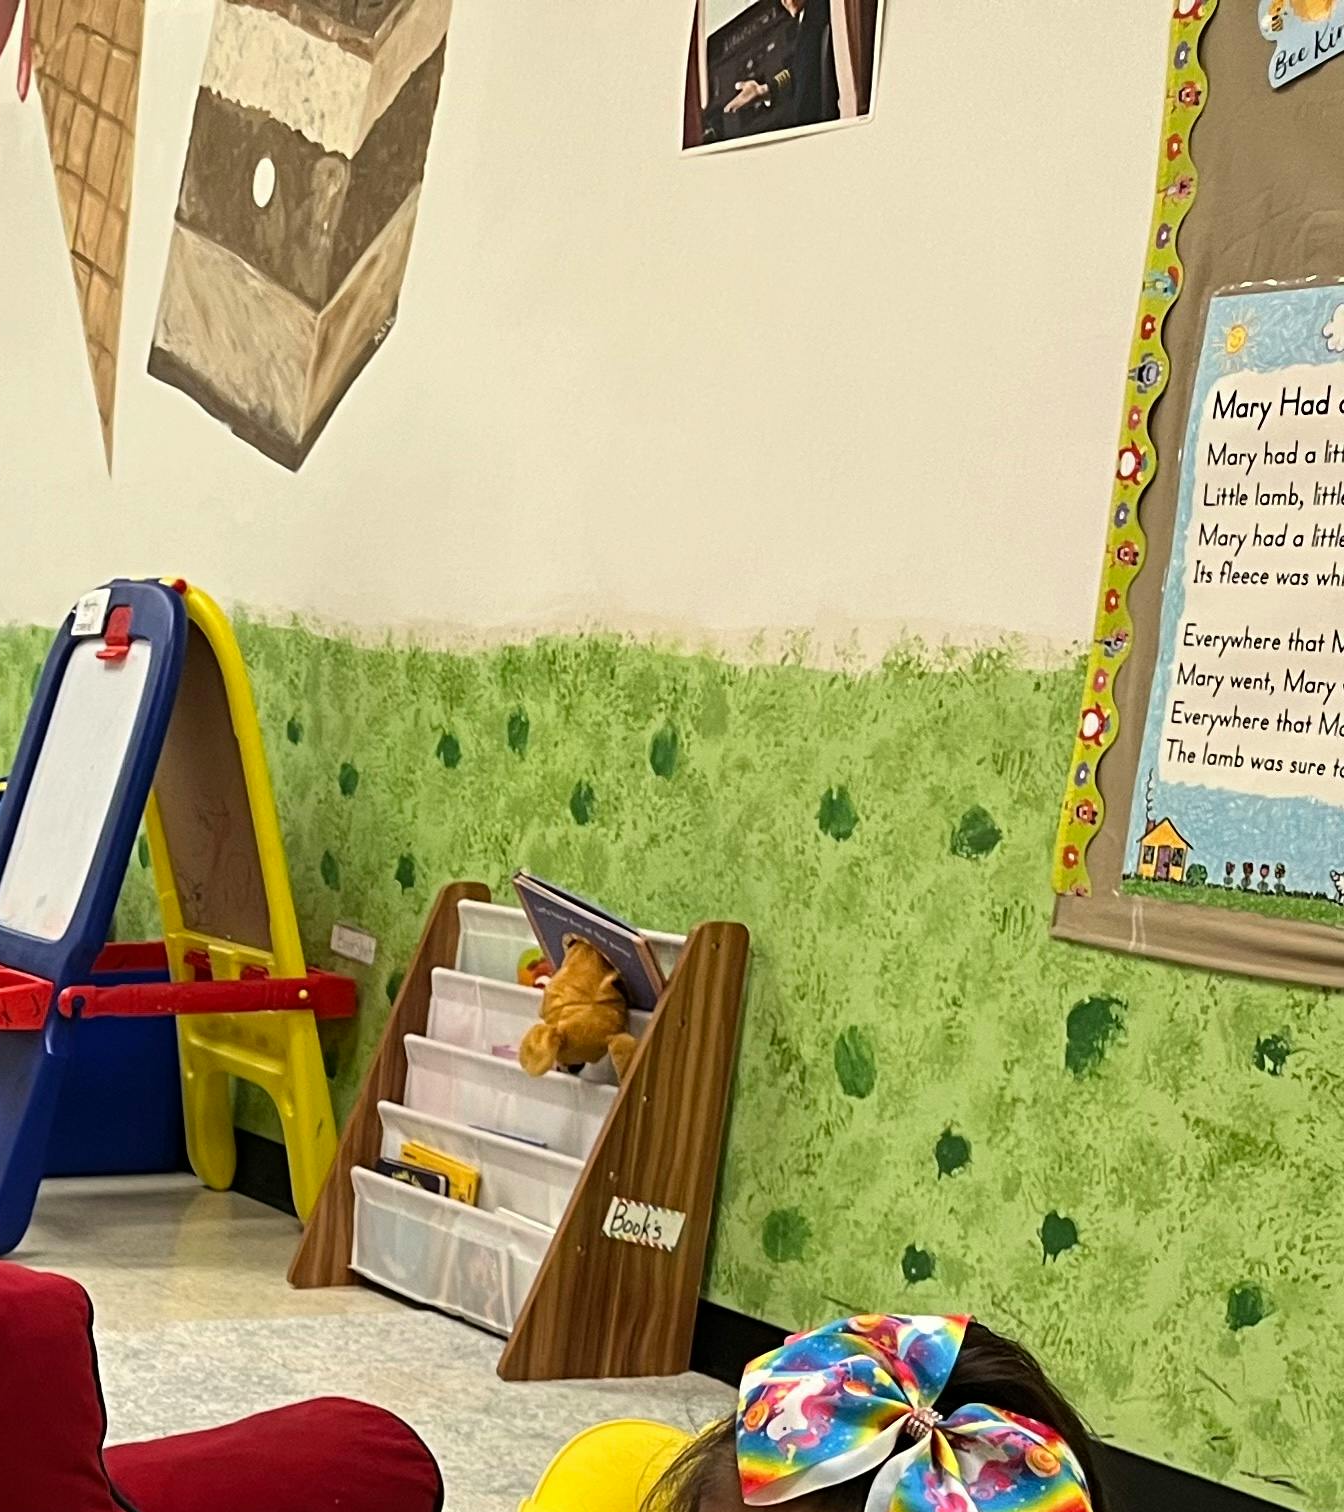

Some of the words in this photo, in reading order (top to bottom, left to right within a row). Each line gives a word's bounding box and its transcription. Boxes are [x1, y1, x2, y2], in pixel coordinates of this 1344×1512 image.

[1274, 46, 1309, 80] Bee
[1212, 389, 1272, 431] Mary
[1279, 384, 1331, 416] Had
[1207, 441, 1257, 476] Mary
[1263, 440, 1299, 465] had
[1305, 451, 1316, 463] a
[1203, 482, 1248, 507] Little
[1254, 480, 1304, 511] lamb,
[1198, 522, 1247, 557] Mary
[1252, 522, 1288, 547] had
[1292, 534, 1304, 547] a
[1193, 559, 1213, 584] Its
[1219, 560, 1269, 585] fleece
[1276, 572, 1309, 587] was
[1183, 622, 1281, 658] Everywhere
[1288, 627, 1325, 653] that
[1176, 662, 1224, 698] Mary
[1230, 671, 1275, 696] went,
[1283, 668, 1336, 706] Mary
[1171, 700, 1270, 736] Everywhere
[1276, 708, 1312, 733] that
[1166, 738, 1196, 764] The
[1202, 741, 1244, 768] lamb
[1250, 755, 1283, 772] was
[1289, 760, 1326, 776] sure
